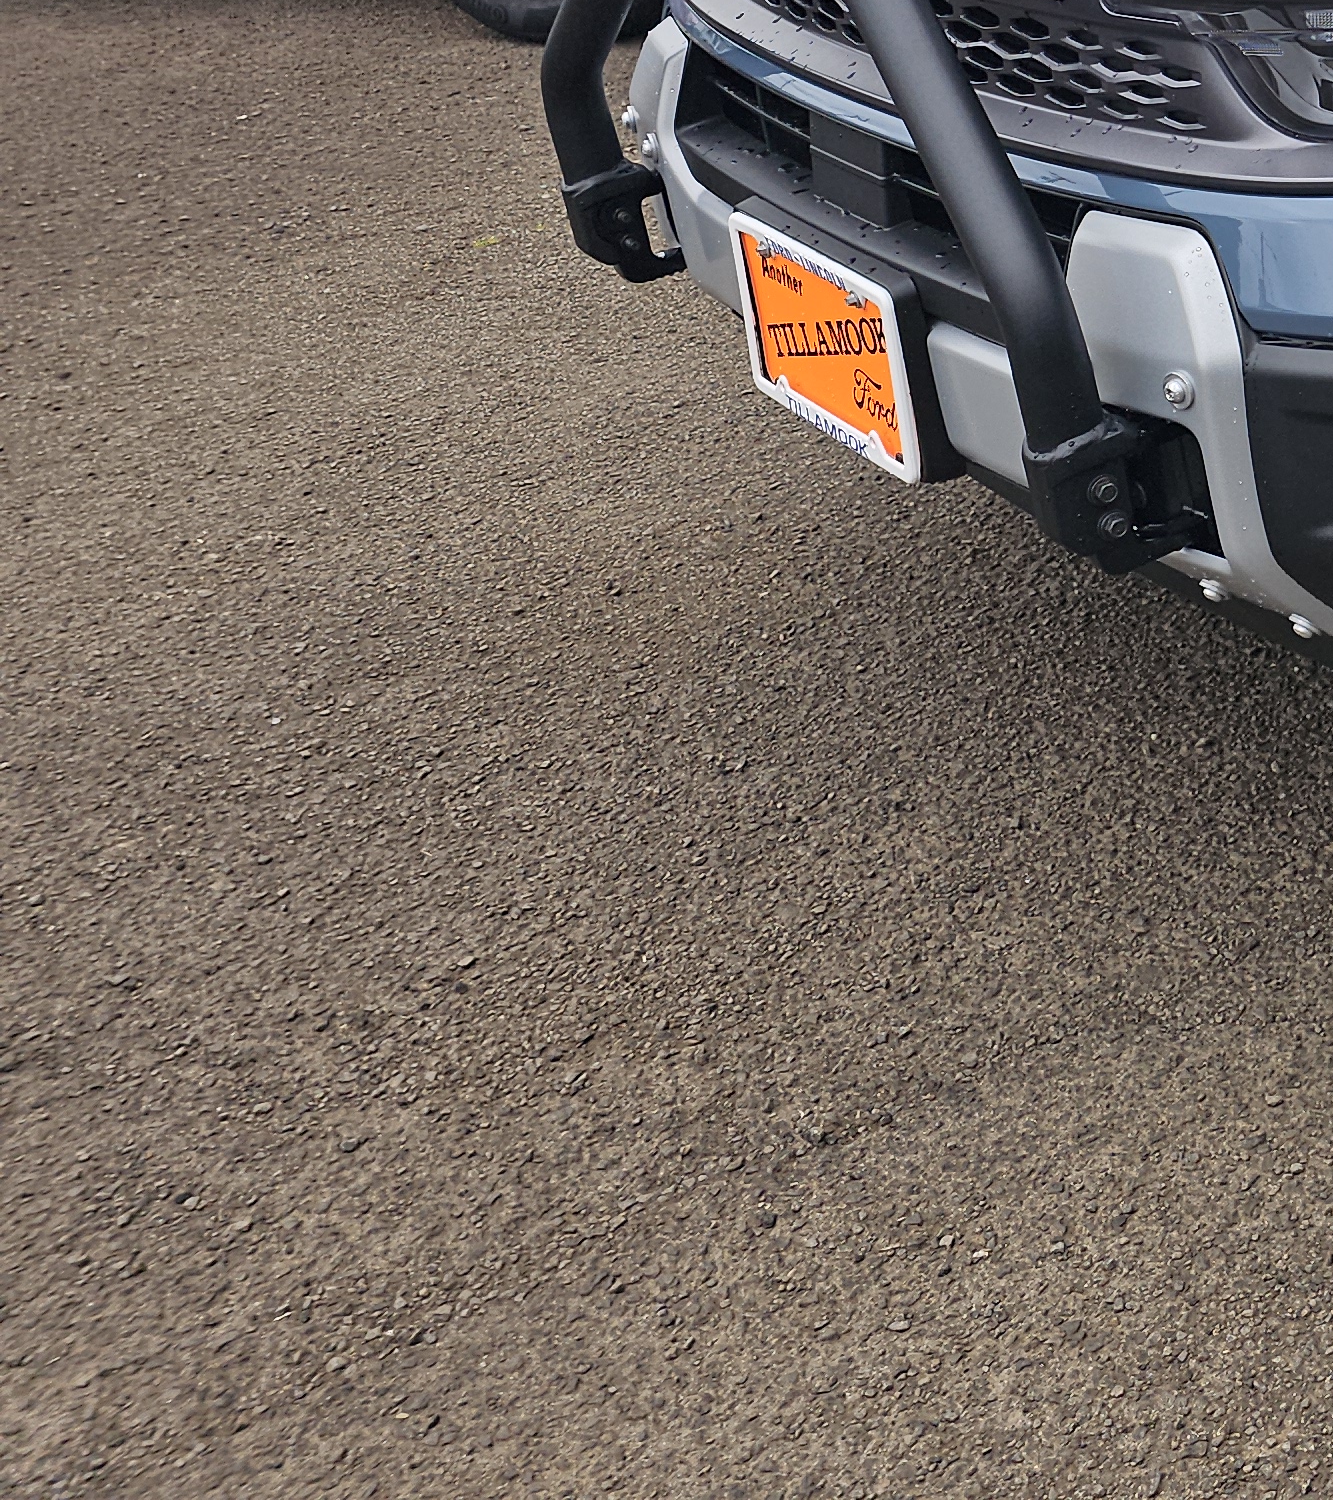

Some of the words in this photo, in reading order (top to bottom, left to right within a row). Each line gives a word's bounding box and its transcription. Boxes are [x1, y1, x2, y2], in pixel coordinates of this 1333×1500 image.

[761, 255, 803, 296] Another
[785, 394, 869, 459] TILLAMOOK
[853, 368, 898, 431] Ford
